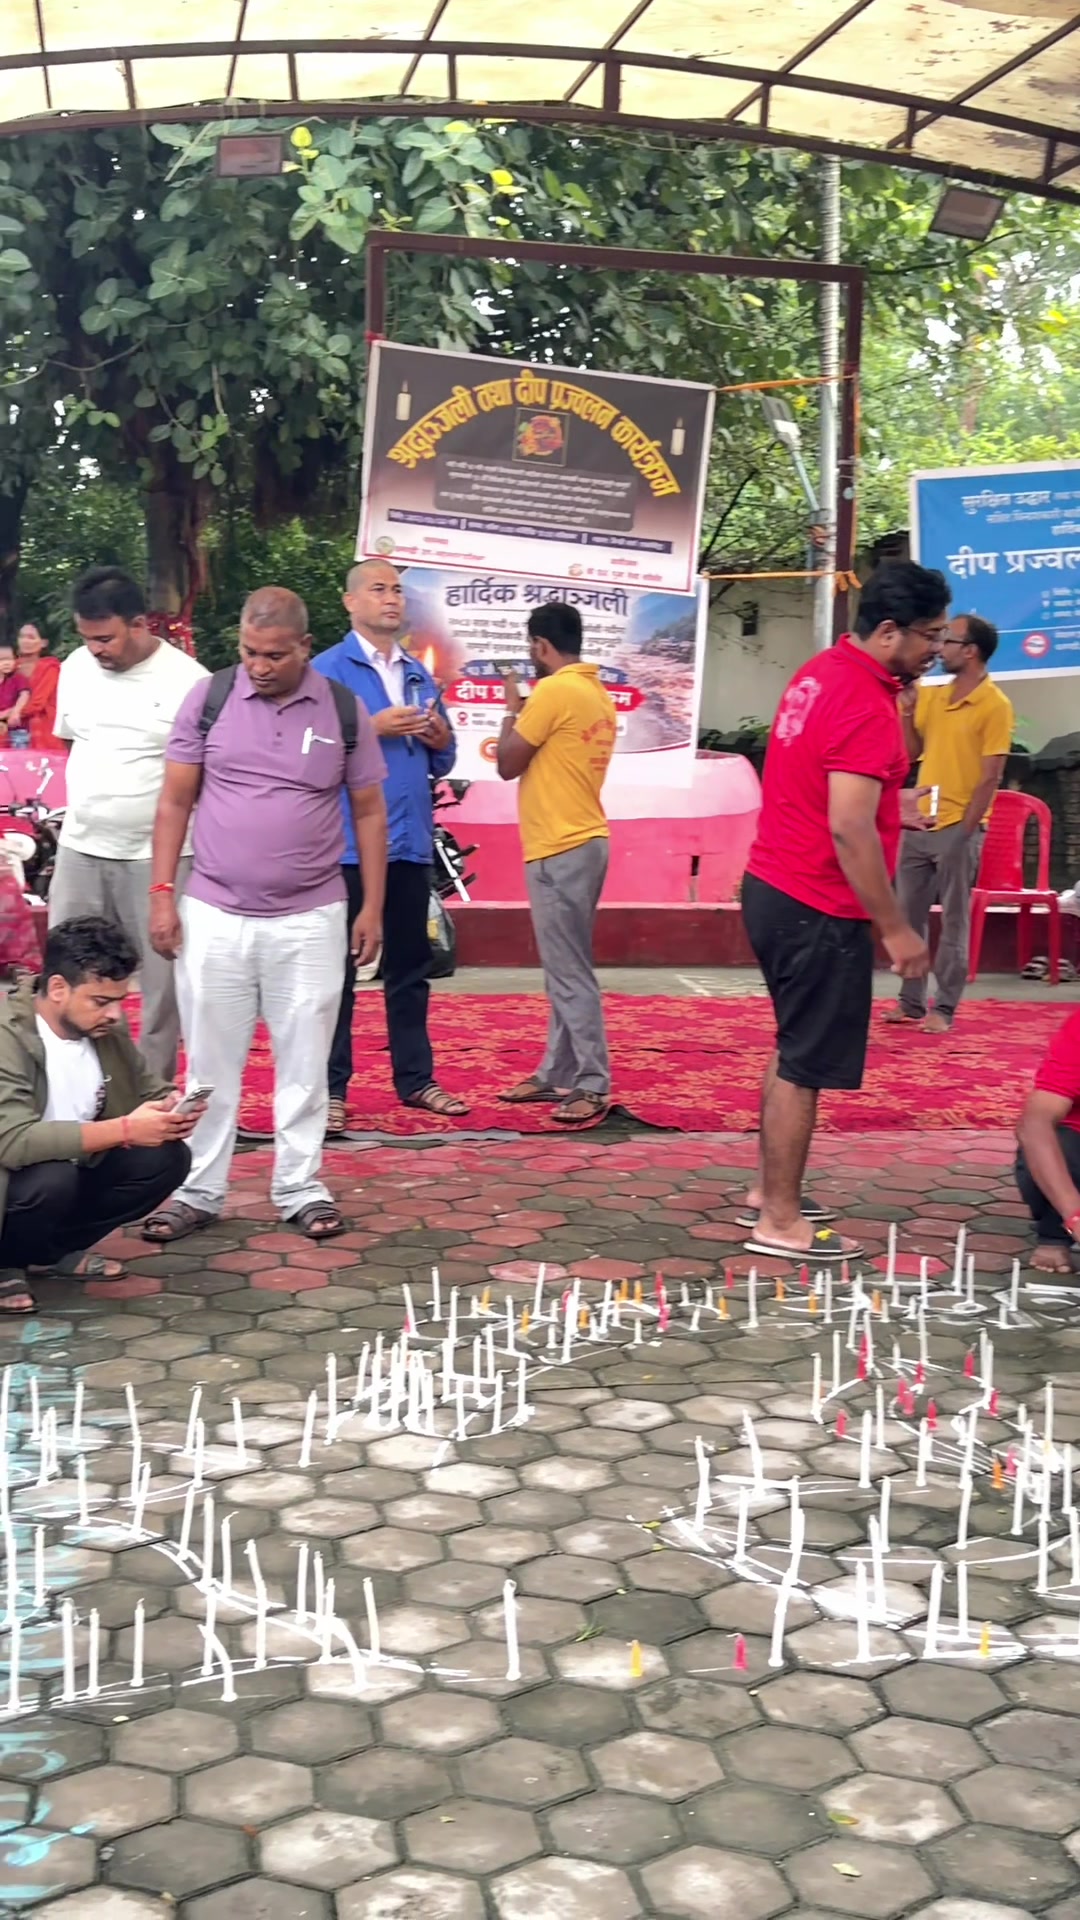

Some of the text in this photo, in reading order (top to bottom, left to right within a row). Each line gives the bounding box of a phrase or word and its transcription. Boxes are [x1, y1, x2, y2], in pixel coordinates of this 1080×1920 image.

[472, 378, 513, 411] तथा
[513, 368, 549, 405] दीप
[549, 379, 621, 430] प्रज्वलन
[611, 416, 681, 497] कार्यक्रम
[946, 545, 1080, 579] दीप प्रज्वल
[445, 577, 517, 606] हार्दिक
[455, 680, 489, 700] दीप
